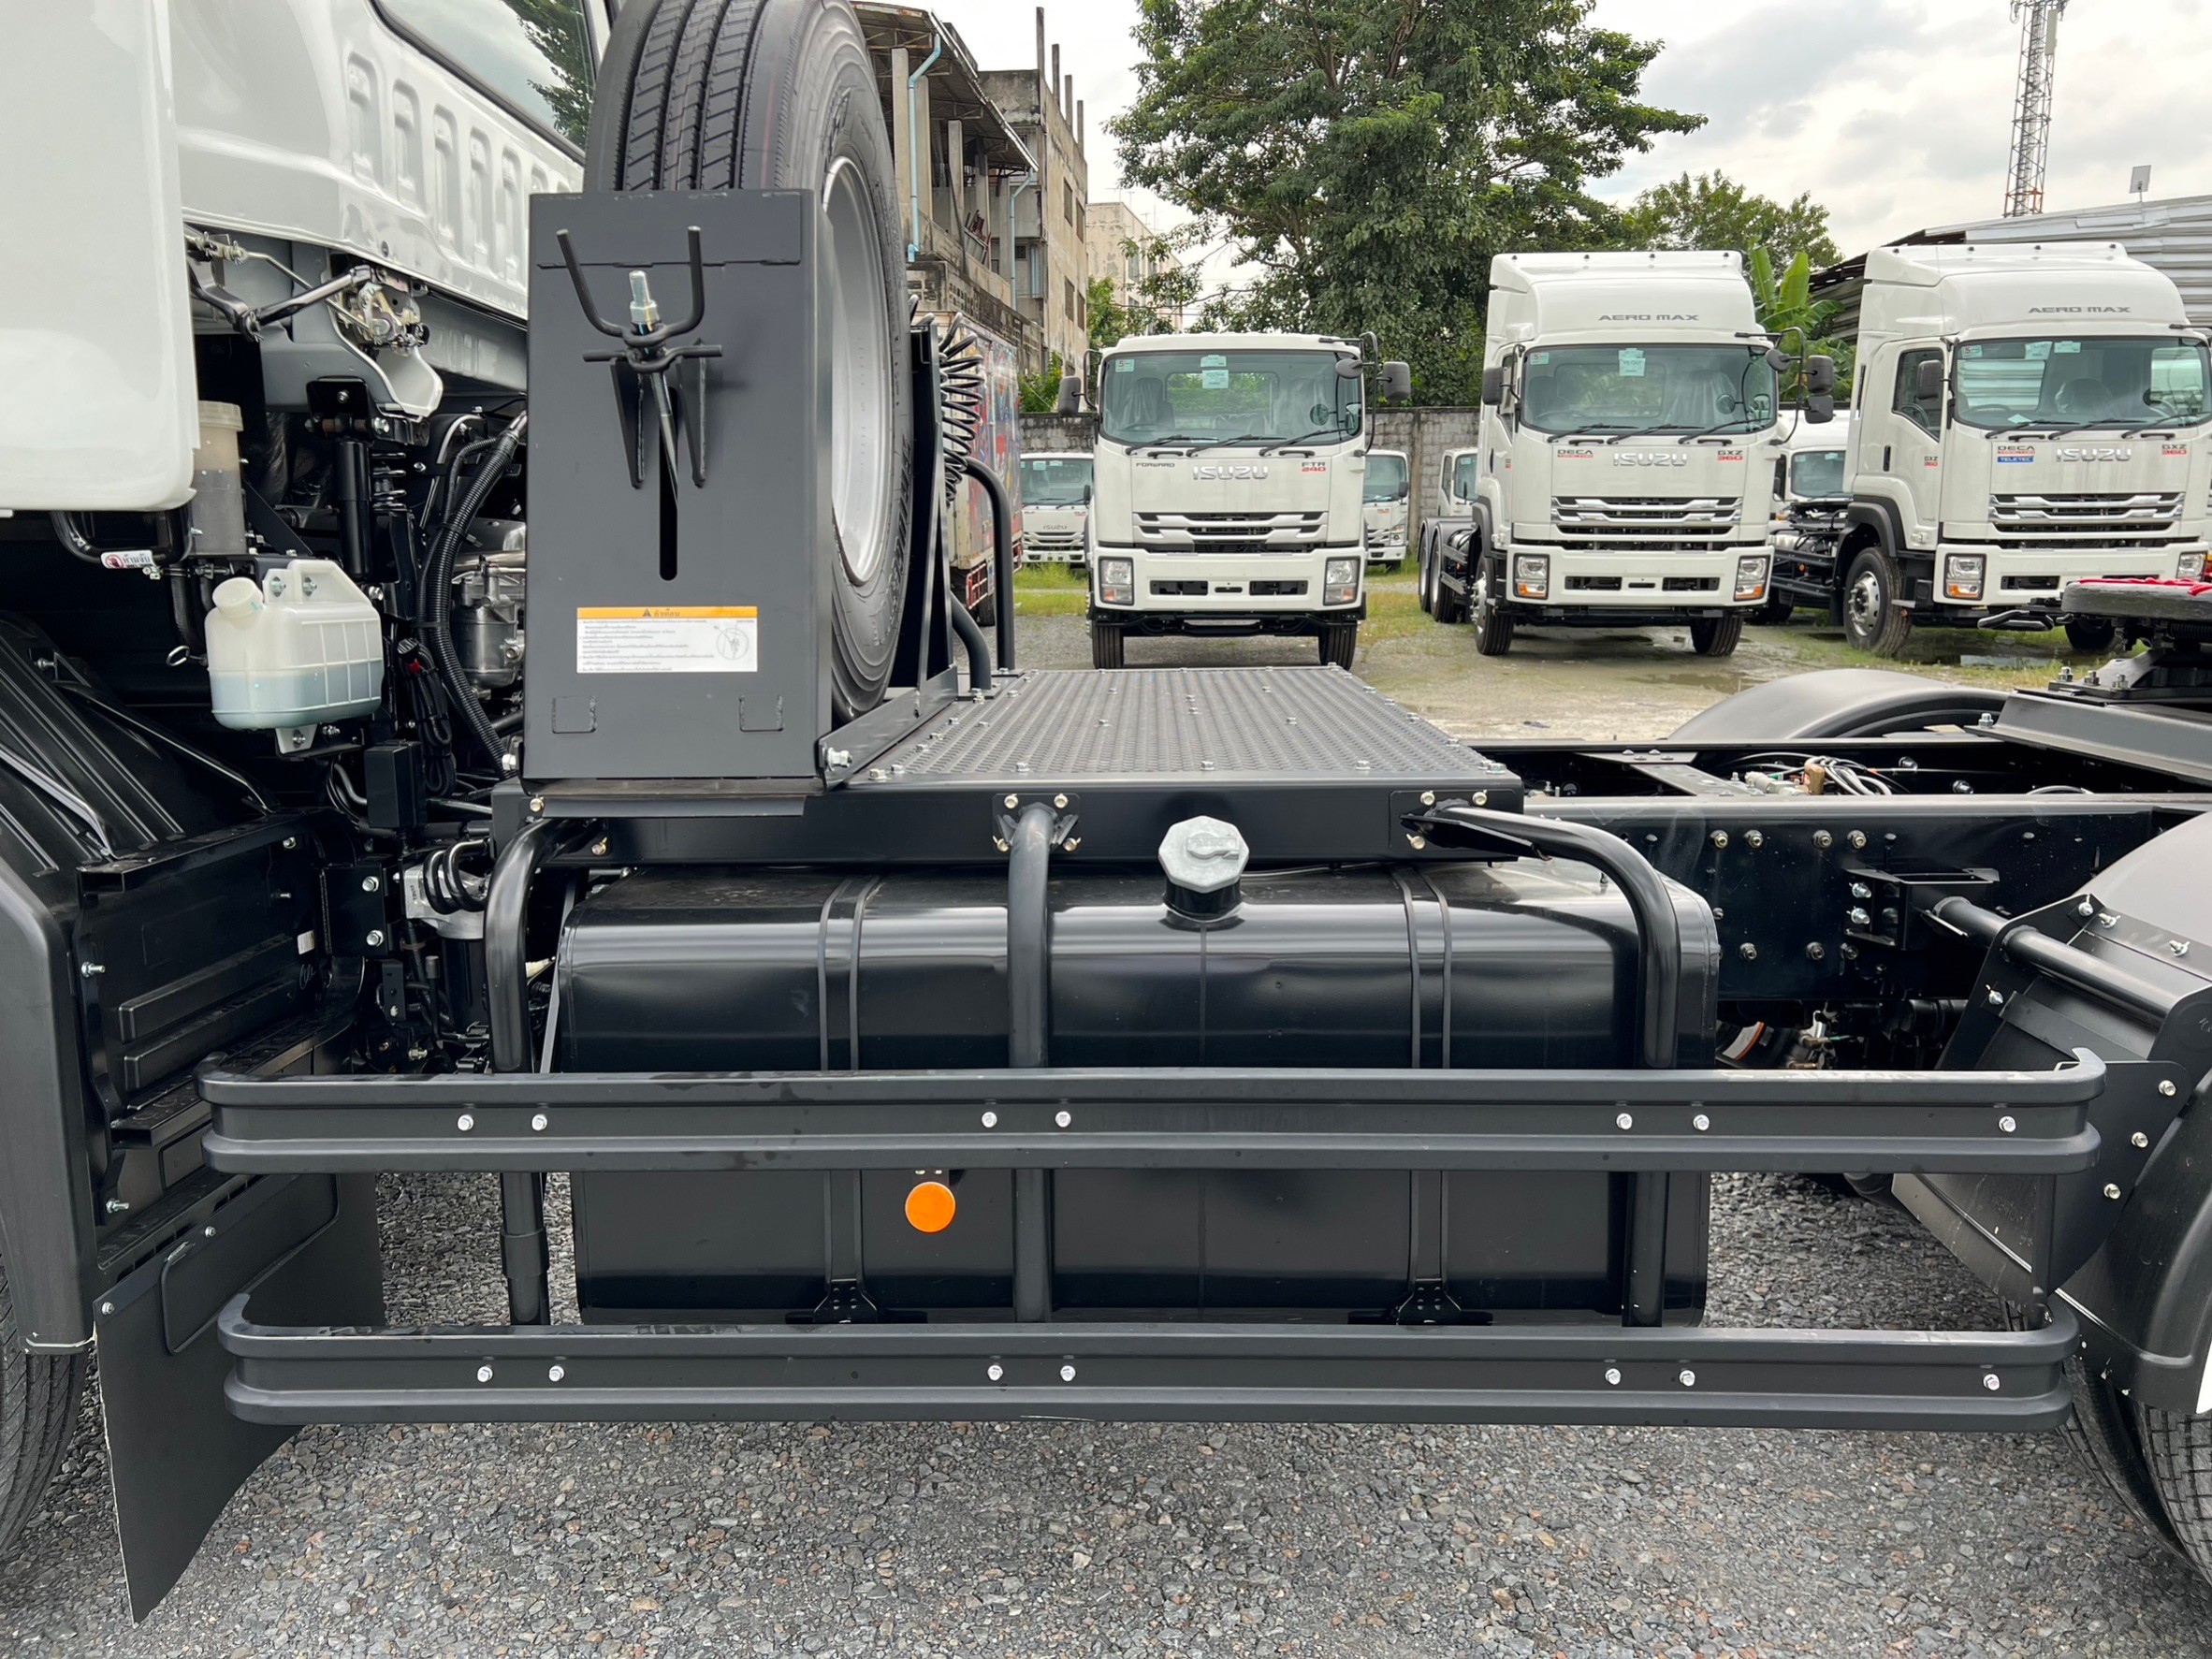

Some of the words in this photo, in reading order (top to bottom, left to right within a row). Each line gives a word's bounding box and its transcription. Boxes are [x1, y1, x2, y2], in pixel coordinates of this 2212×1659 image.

[1612, 452, 1688, 467] ISUZU
[2055, 448, 2132, 463] ISUZU
[1192, 465, 1270, 481] ISUZU
